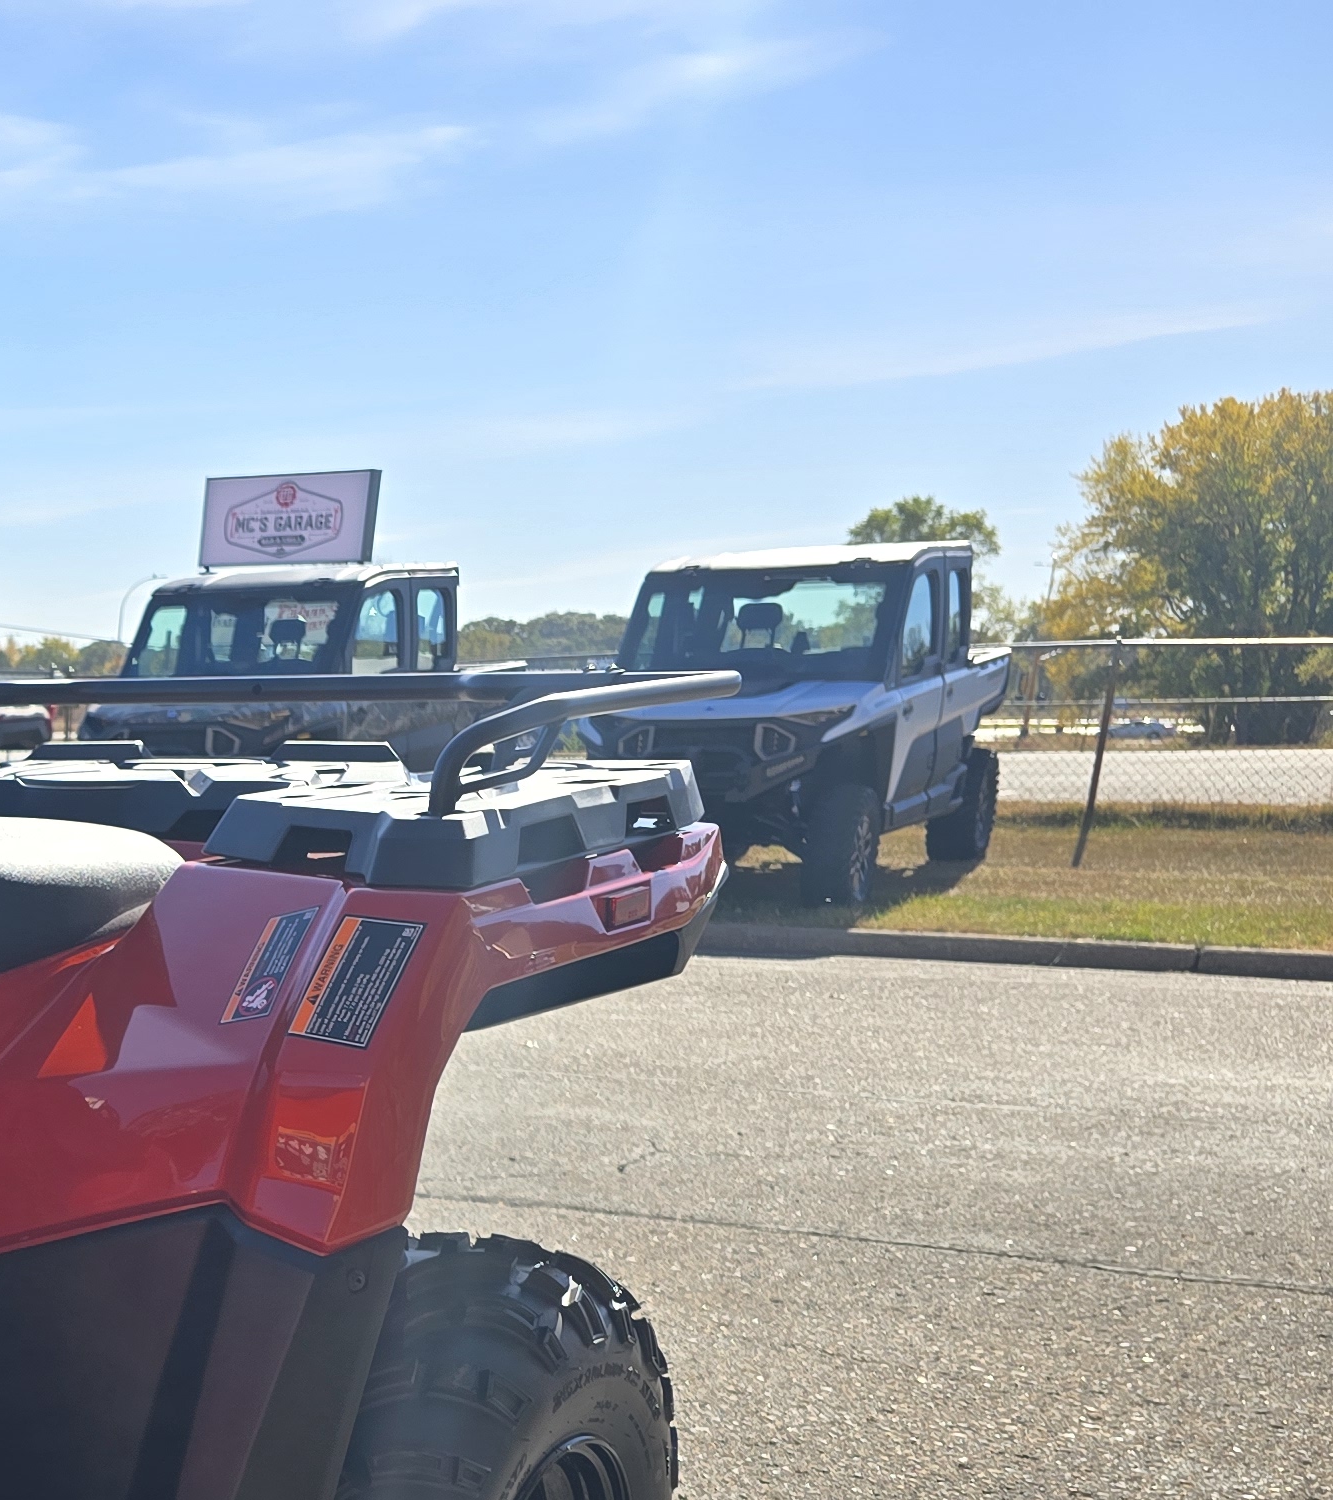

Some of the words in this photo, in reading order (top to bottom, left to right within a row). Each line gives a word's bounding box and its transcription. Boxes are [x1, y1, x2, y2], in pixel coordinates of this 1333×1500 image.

[235, 515, 270, 533] MC'S
[273, 512, 334, 533] GARAGE
[311, 943, 344, 993] WARNING
